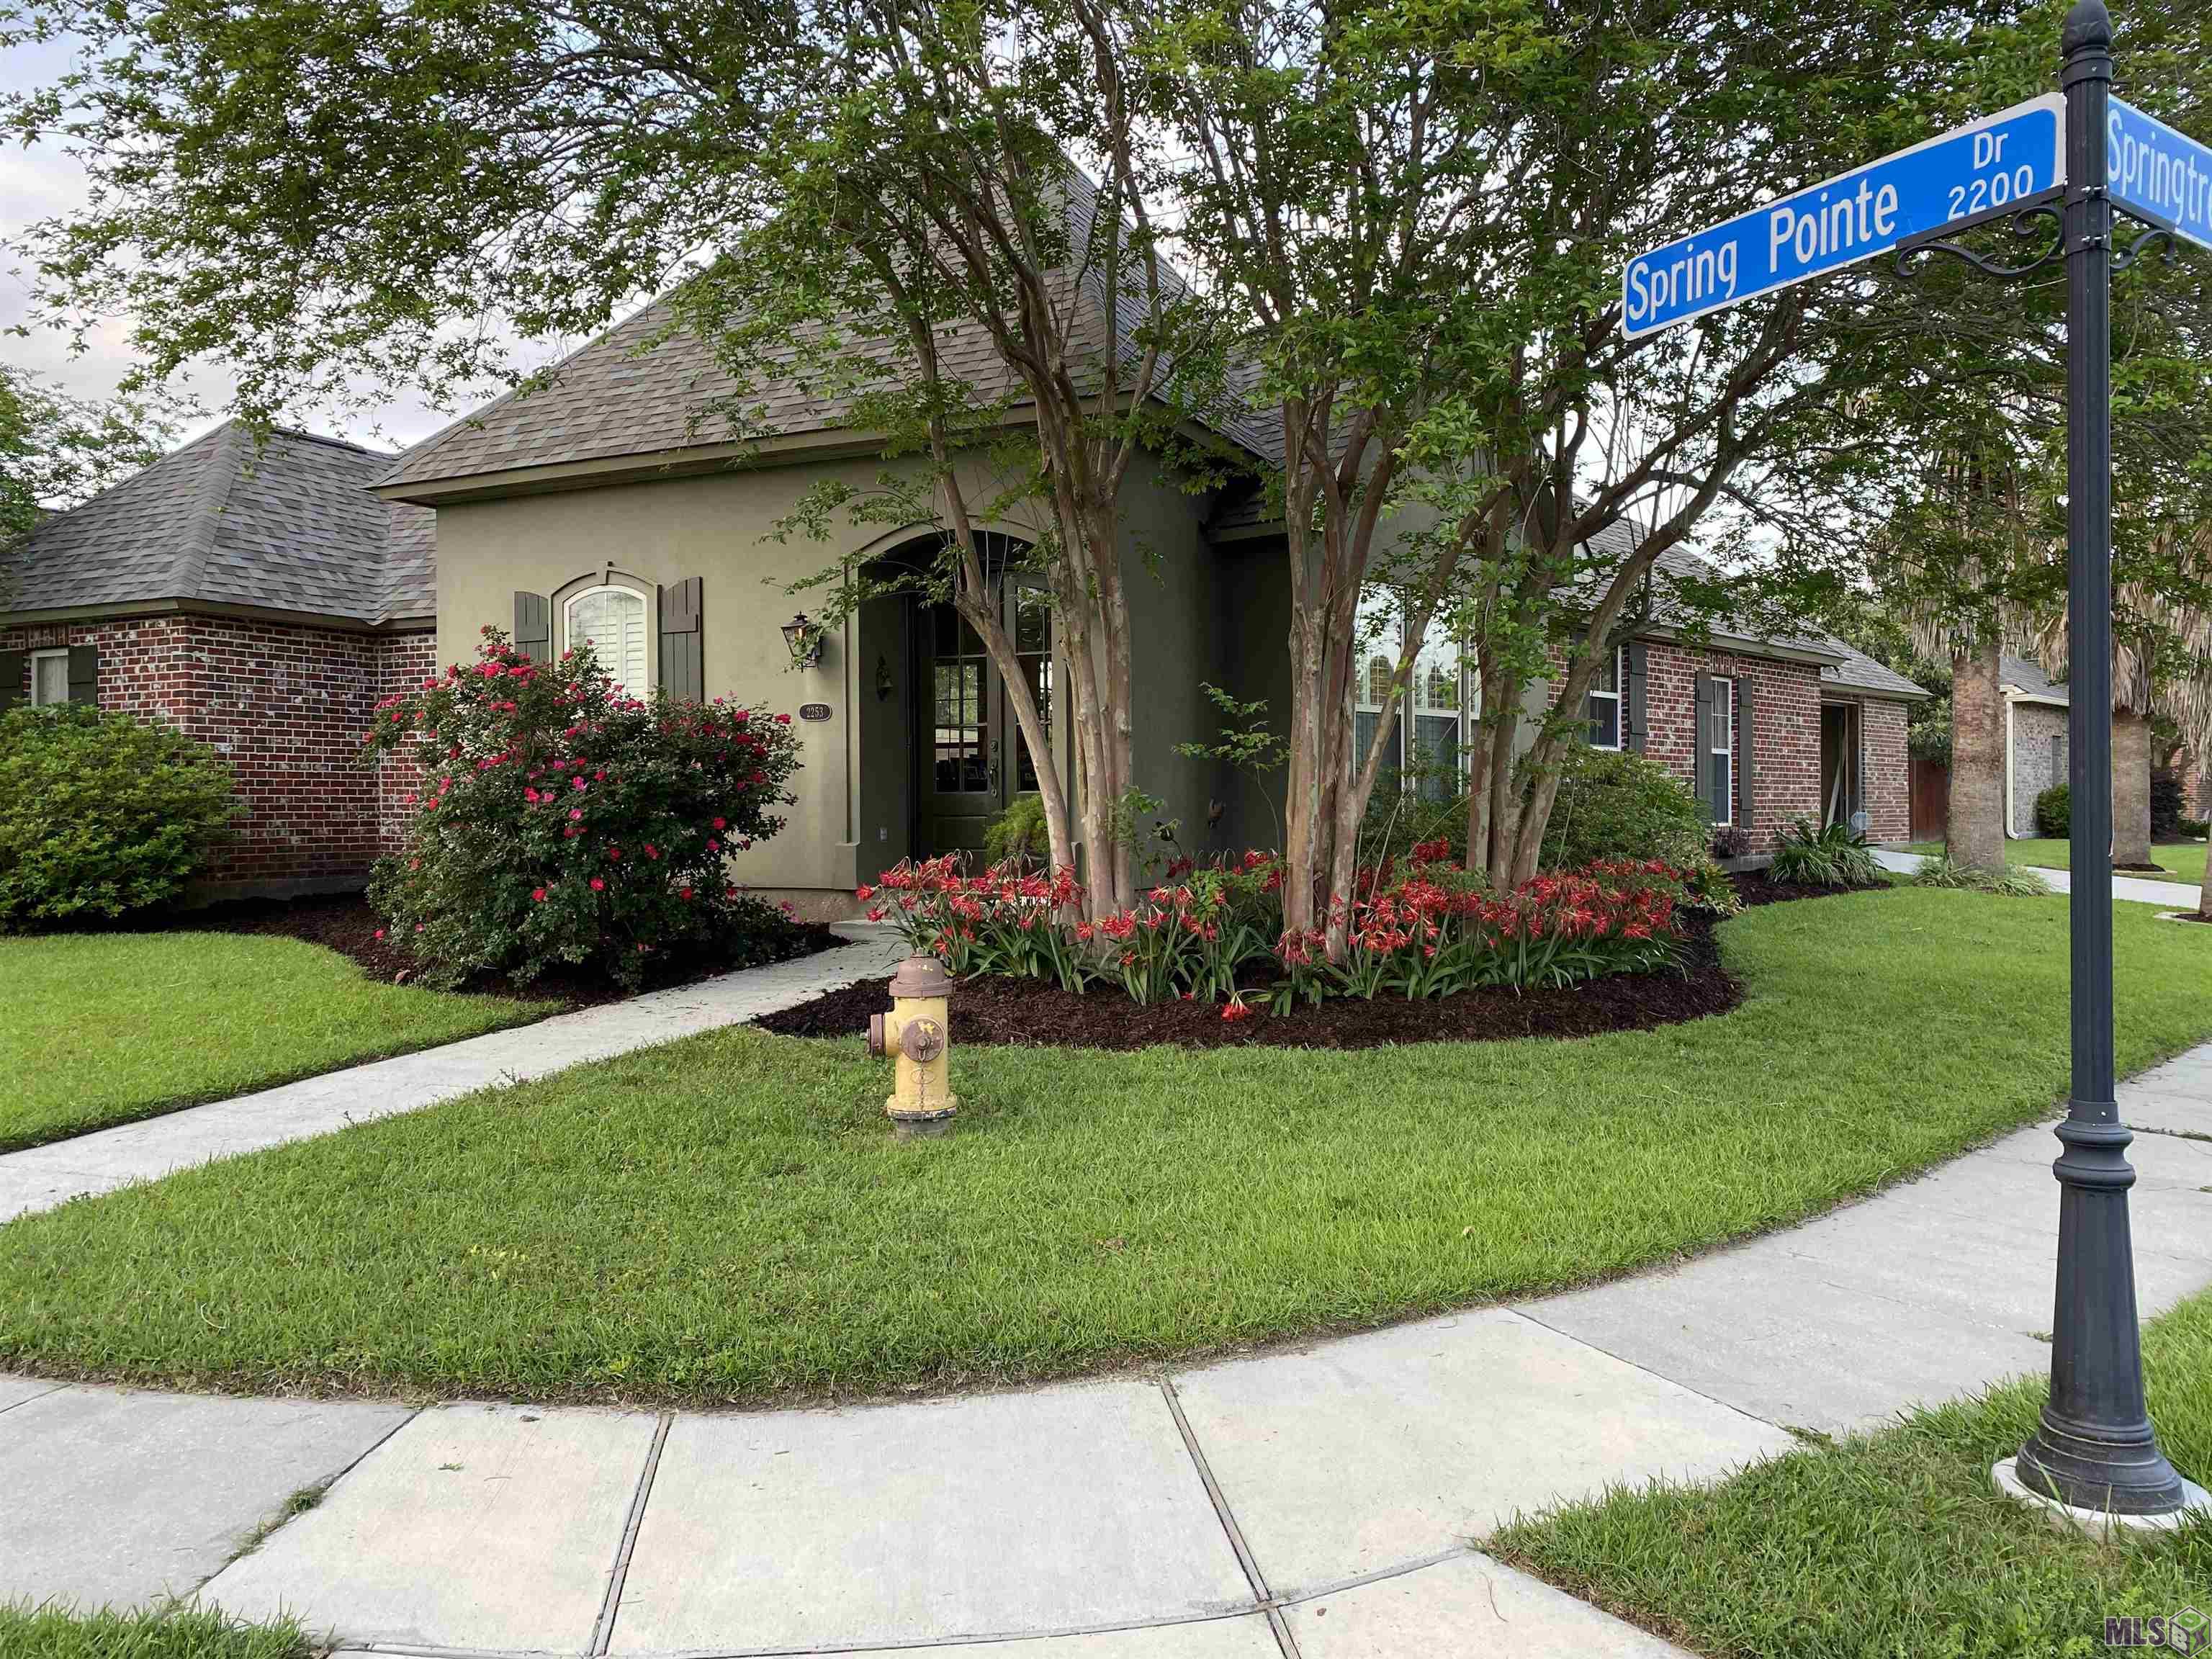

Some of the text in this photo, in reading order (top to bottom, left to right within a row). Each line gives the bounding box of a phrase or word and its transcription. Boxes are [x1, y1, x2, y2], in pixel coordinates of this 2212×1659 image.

[1947, 164, 2034, 220] 2200
[1628, 131, 2009, 322] Spring Pointe Dr
[806, 706, 824, 717] 2253
